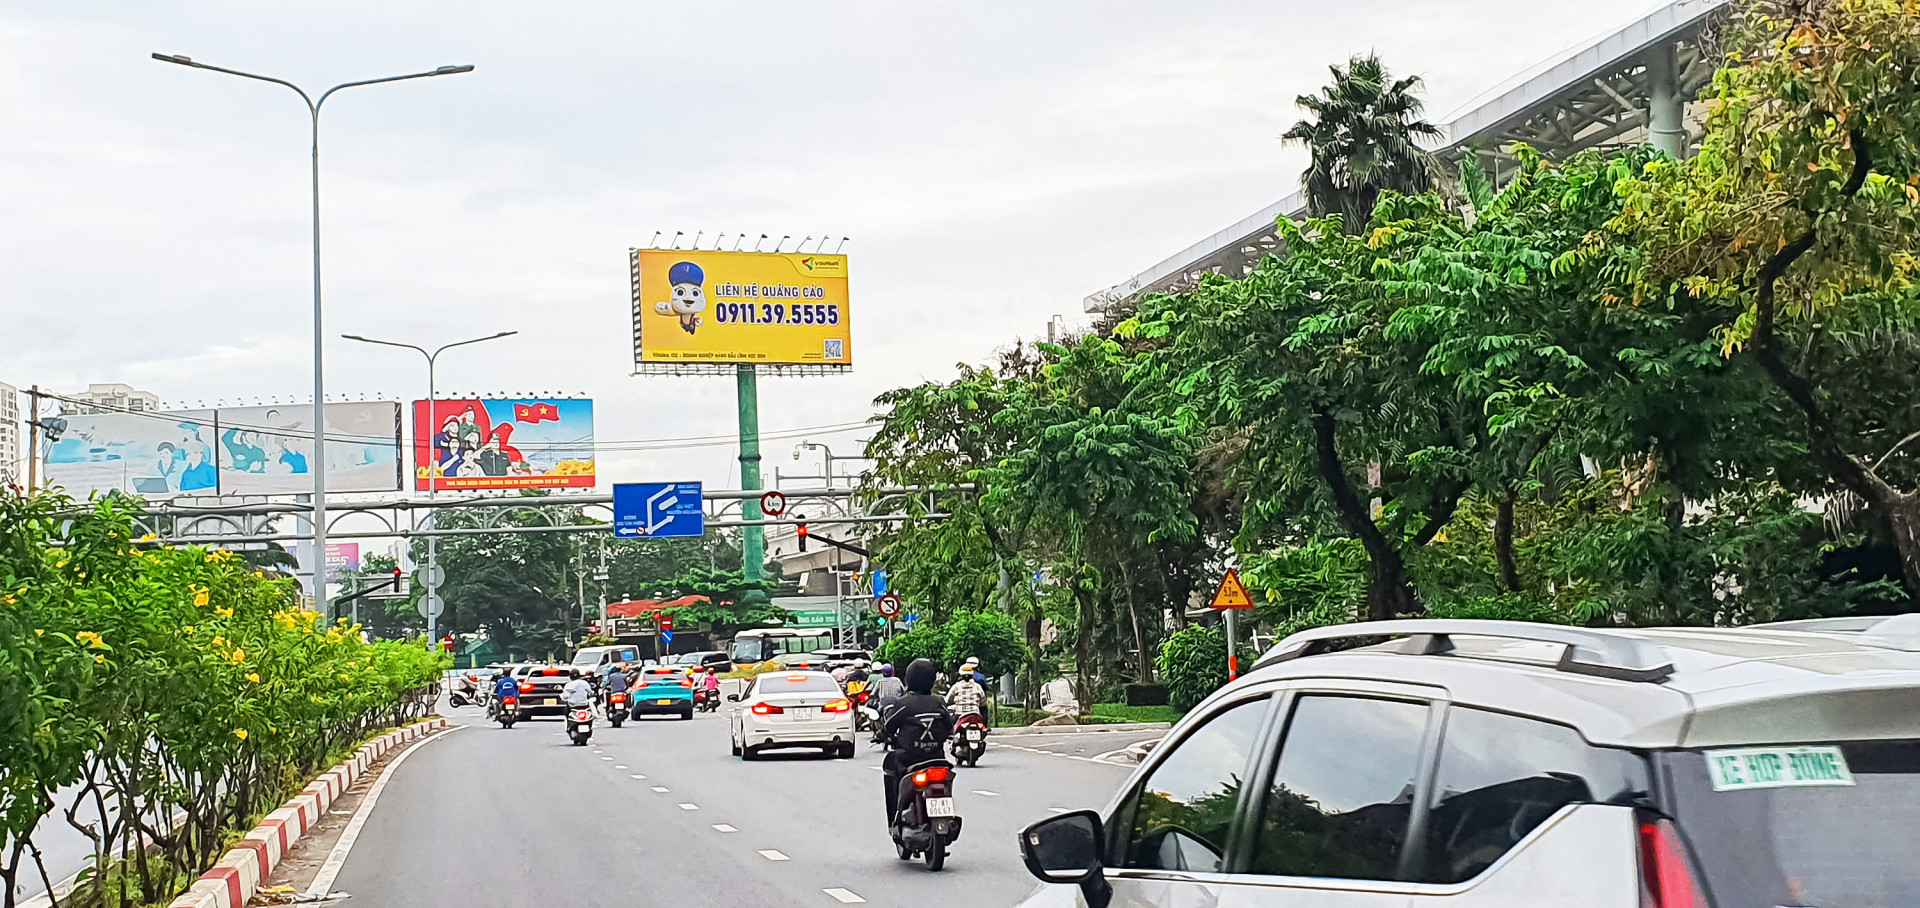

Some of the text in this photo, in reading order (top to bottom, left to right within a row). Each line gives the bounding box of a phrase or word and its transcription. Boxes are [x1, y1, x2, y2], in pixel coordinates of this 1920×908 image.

[715, 282, 740, 297] LIÊN
[744, 282, 758, 300] HỆ
[715, 302, 839, 325] 0911.39.5555
